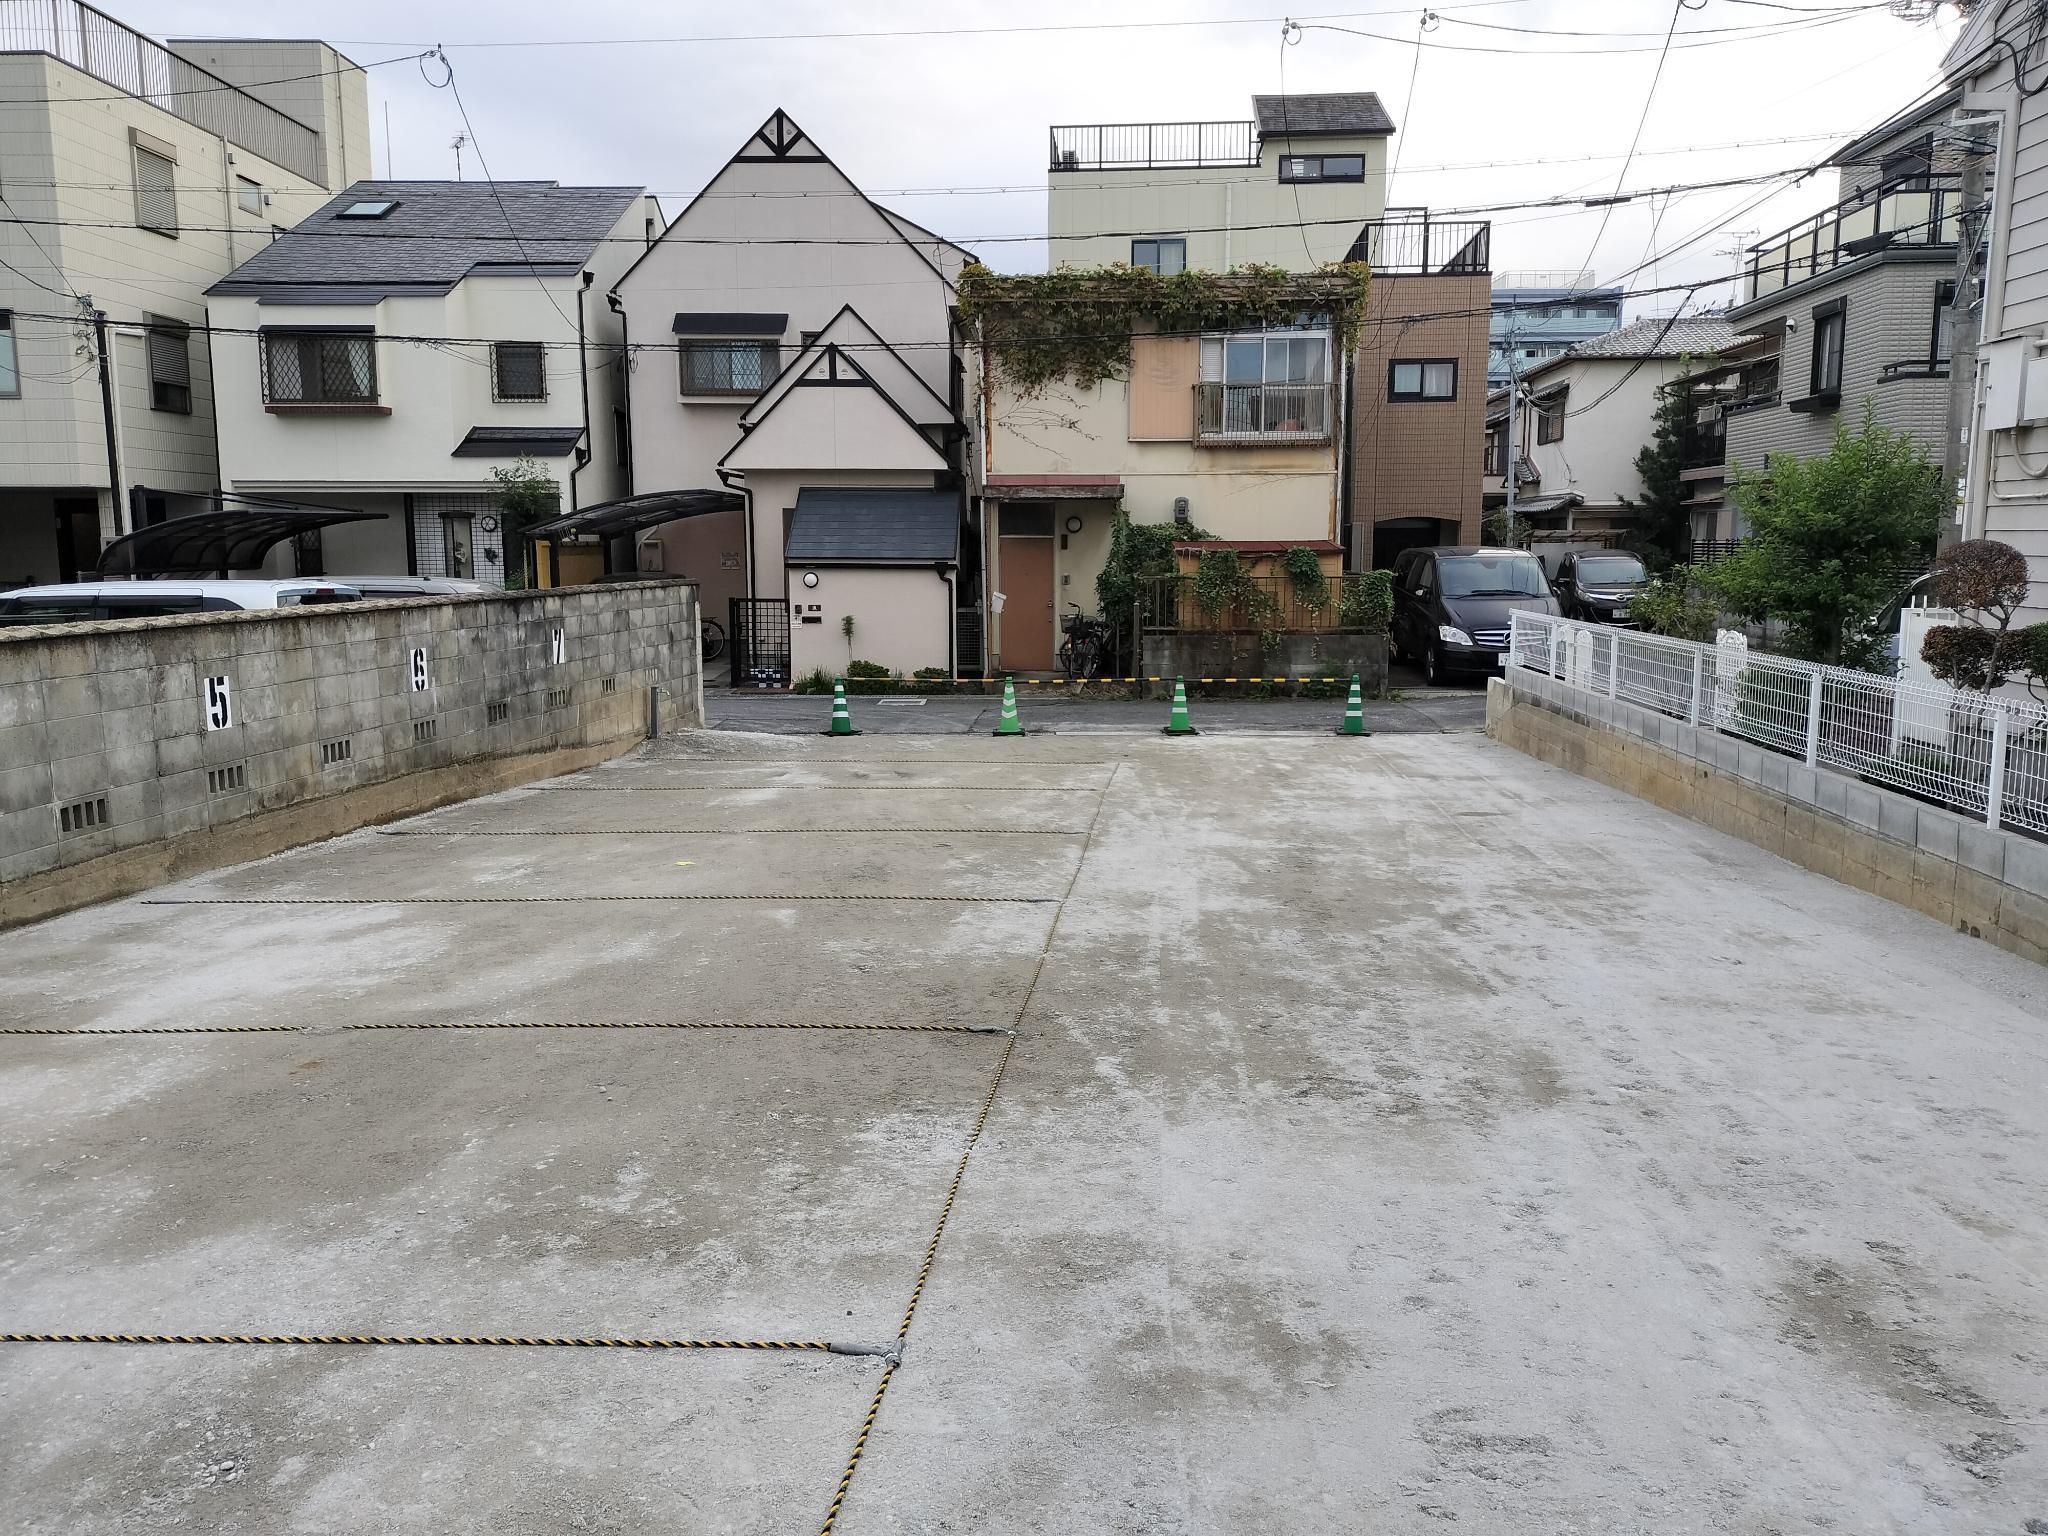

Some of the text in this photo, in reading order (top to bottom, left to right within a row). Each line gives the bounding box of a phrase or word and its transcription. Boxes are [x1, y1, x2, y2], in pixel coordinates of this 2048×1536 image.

[553, 629, 562, 664] 7
[413, 648, 425, 691] 6
[209, 677, 228, 728] 5
